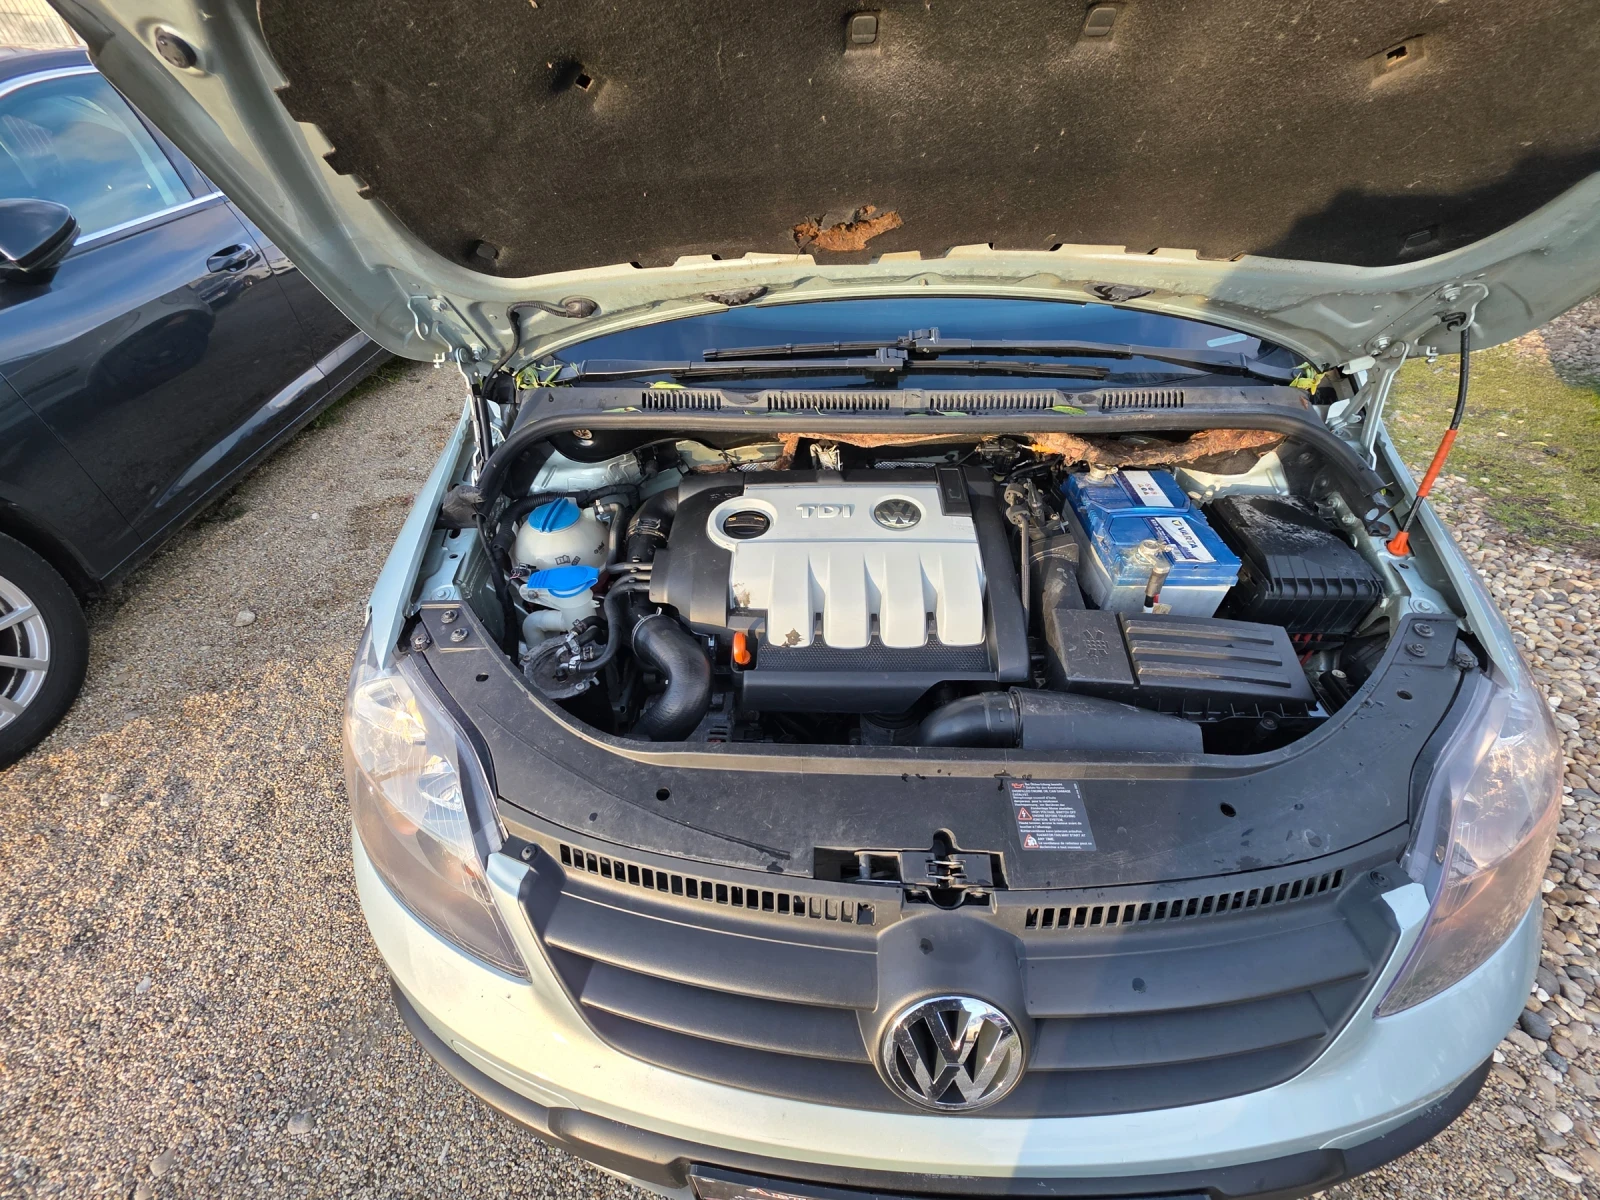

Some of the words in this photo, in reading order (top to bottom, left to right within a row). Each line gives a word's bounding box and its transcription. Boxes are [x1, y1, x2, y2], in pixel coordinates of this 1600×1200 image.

[796, 504, 852, 518] TDI
[1177, 526, 1199, 549] VARTA
[884, 996, 1022, 1110] VW
